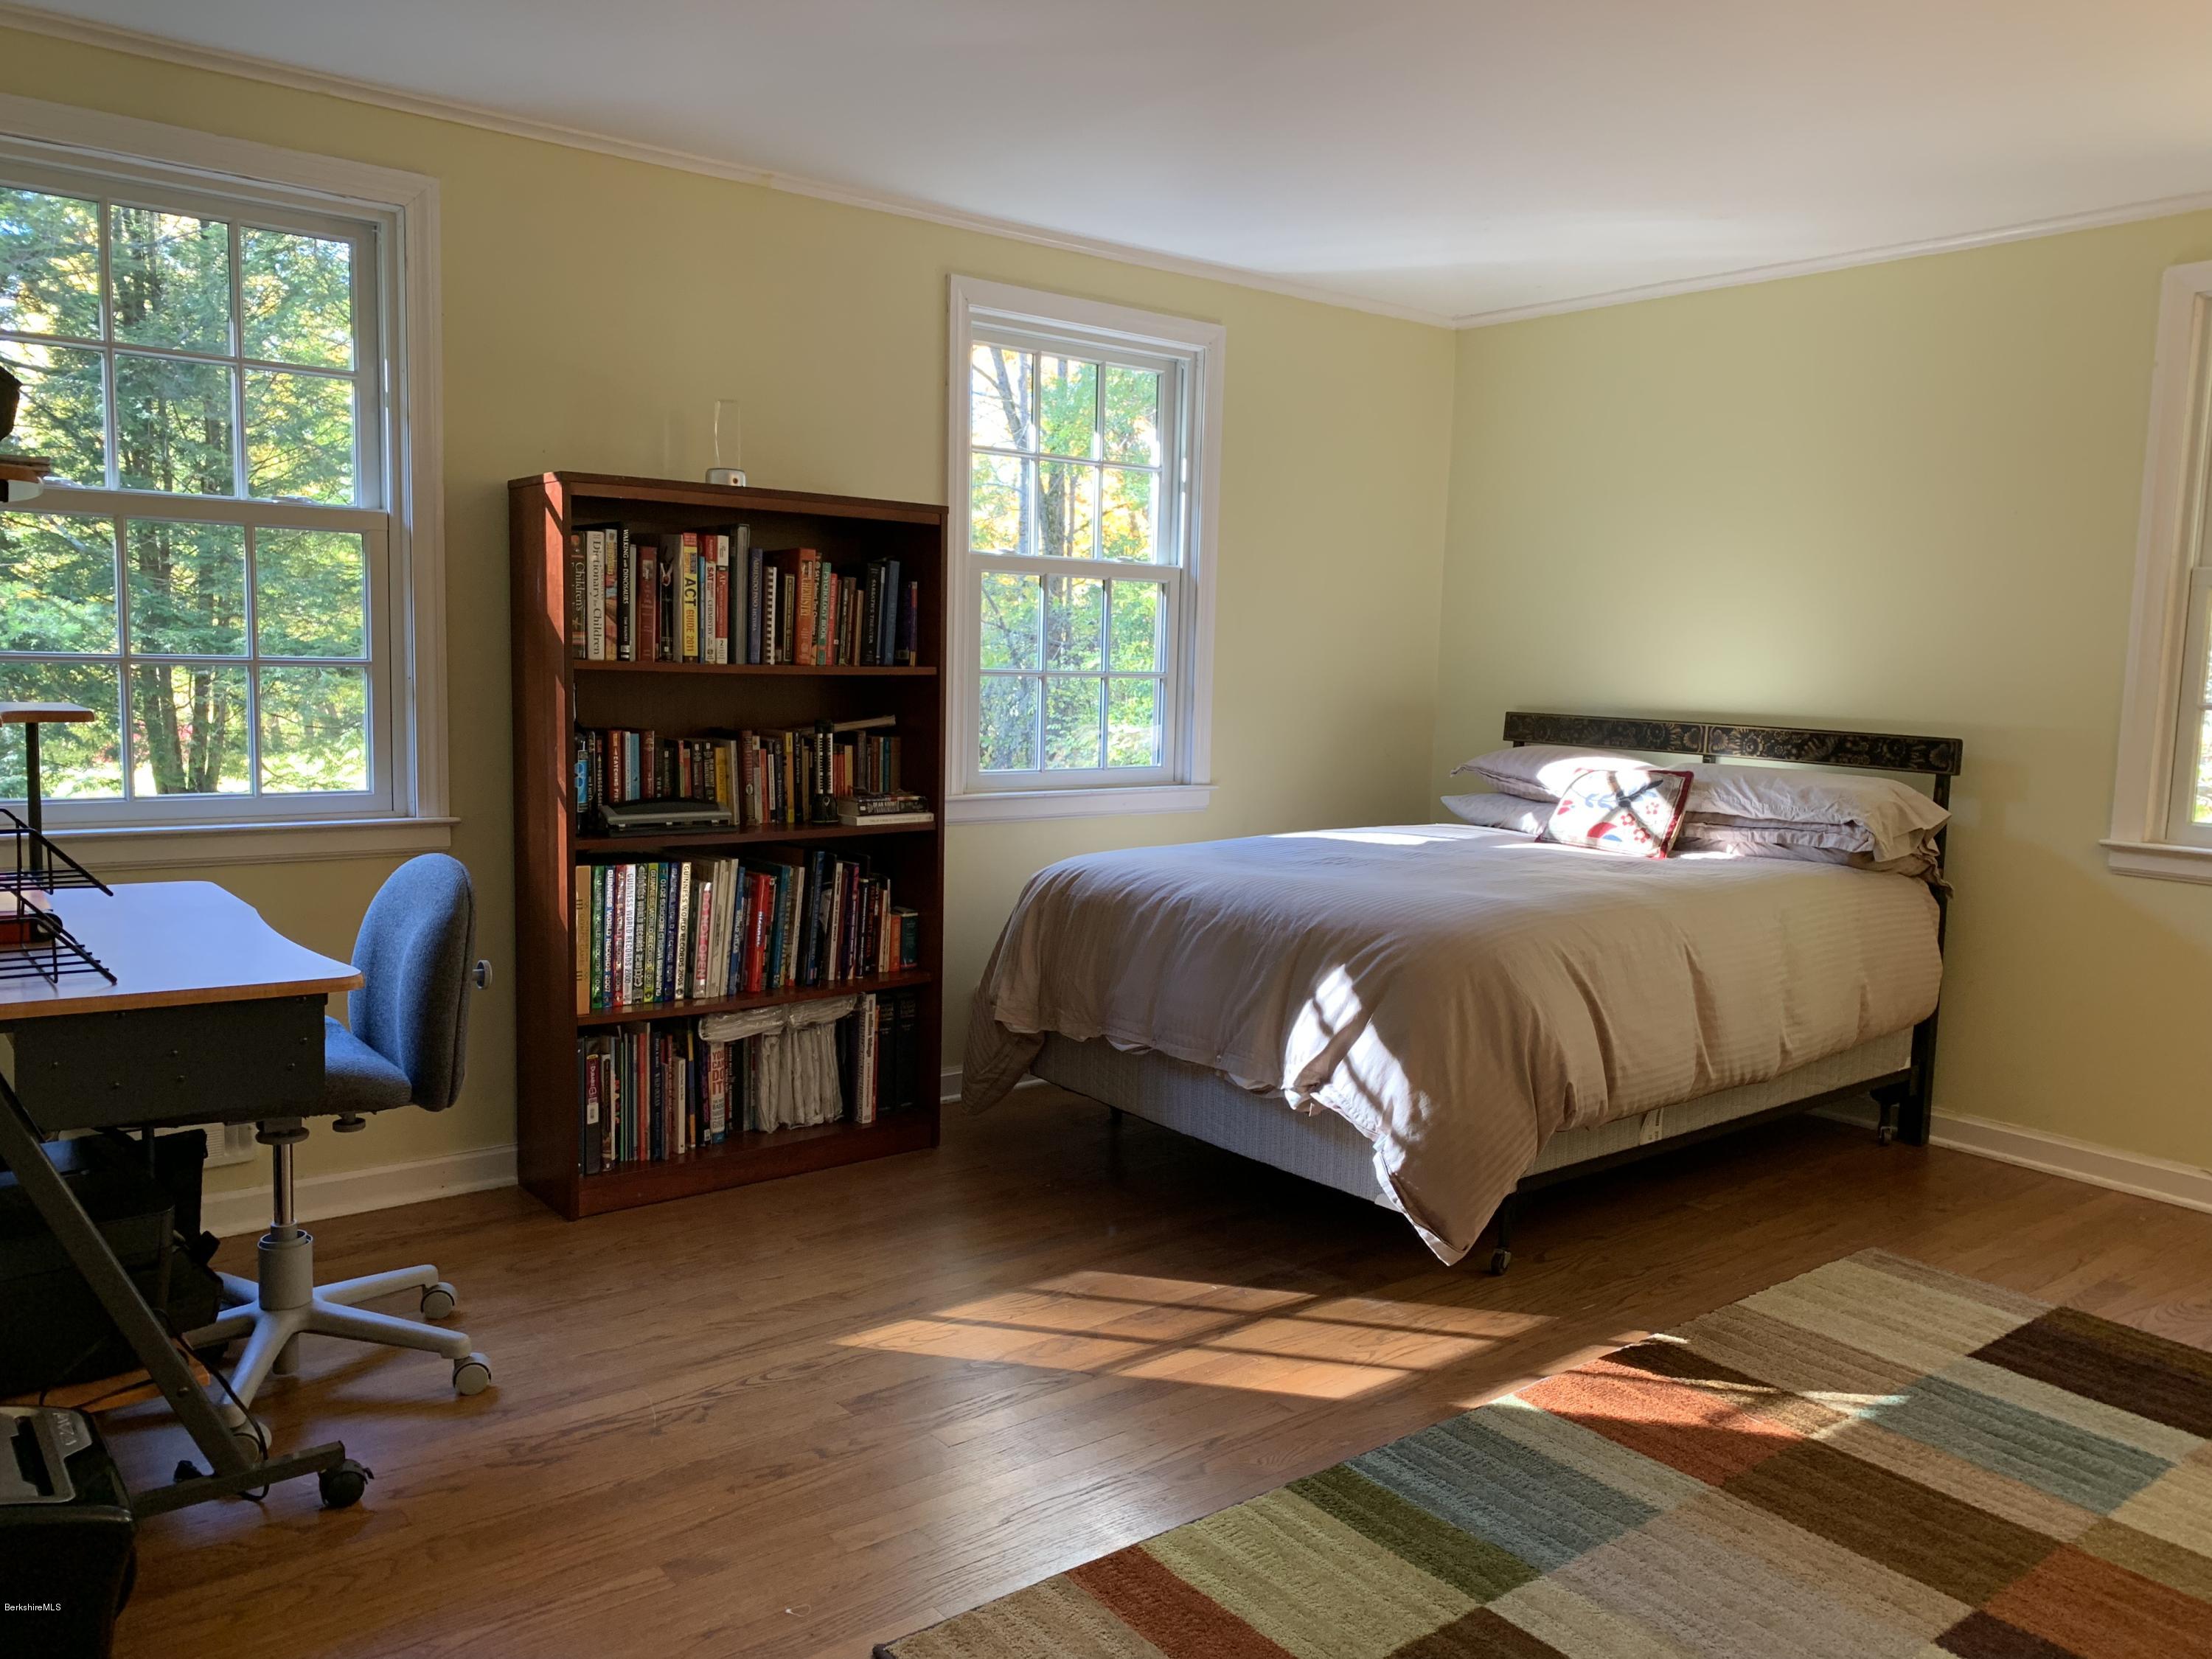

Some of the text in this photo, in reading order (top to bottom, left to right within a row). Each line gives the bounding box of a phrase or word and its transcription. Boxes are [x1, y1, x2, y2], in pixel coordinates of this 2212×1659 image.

[575, 562, 585, 611] Children's
[684, 577, 696, 606] ACT
[720, 574, 726, 584] AP
[821, 571, 830, 616] PSYCHOLOGY
[800, 578, 811, 616] CHEMISTRY
[593, 608, 602, 655] Children
[686, 610, 695, 632] GUIDE
[682, 866, 690, 902] GUINNESS
[636, 924, 644, 953] RECORDS
[656, 933, 664, 959] WORLD
[698, 892, 711, 978] DO NOT OPEN
[712, 1068, 724, 1081] DO
